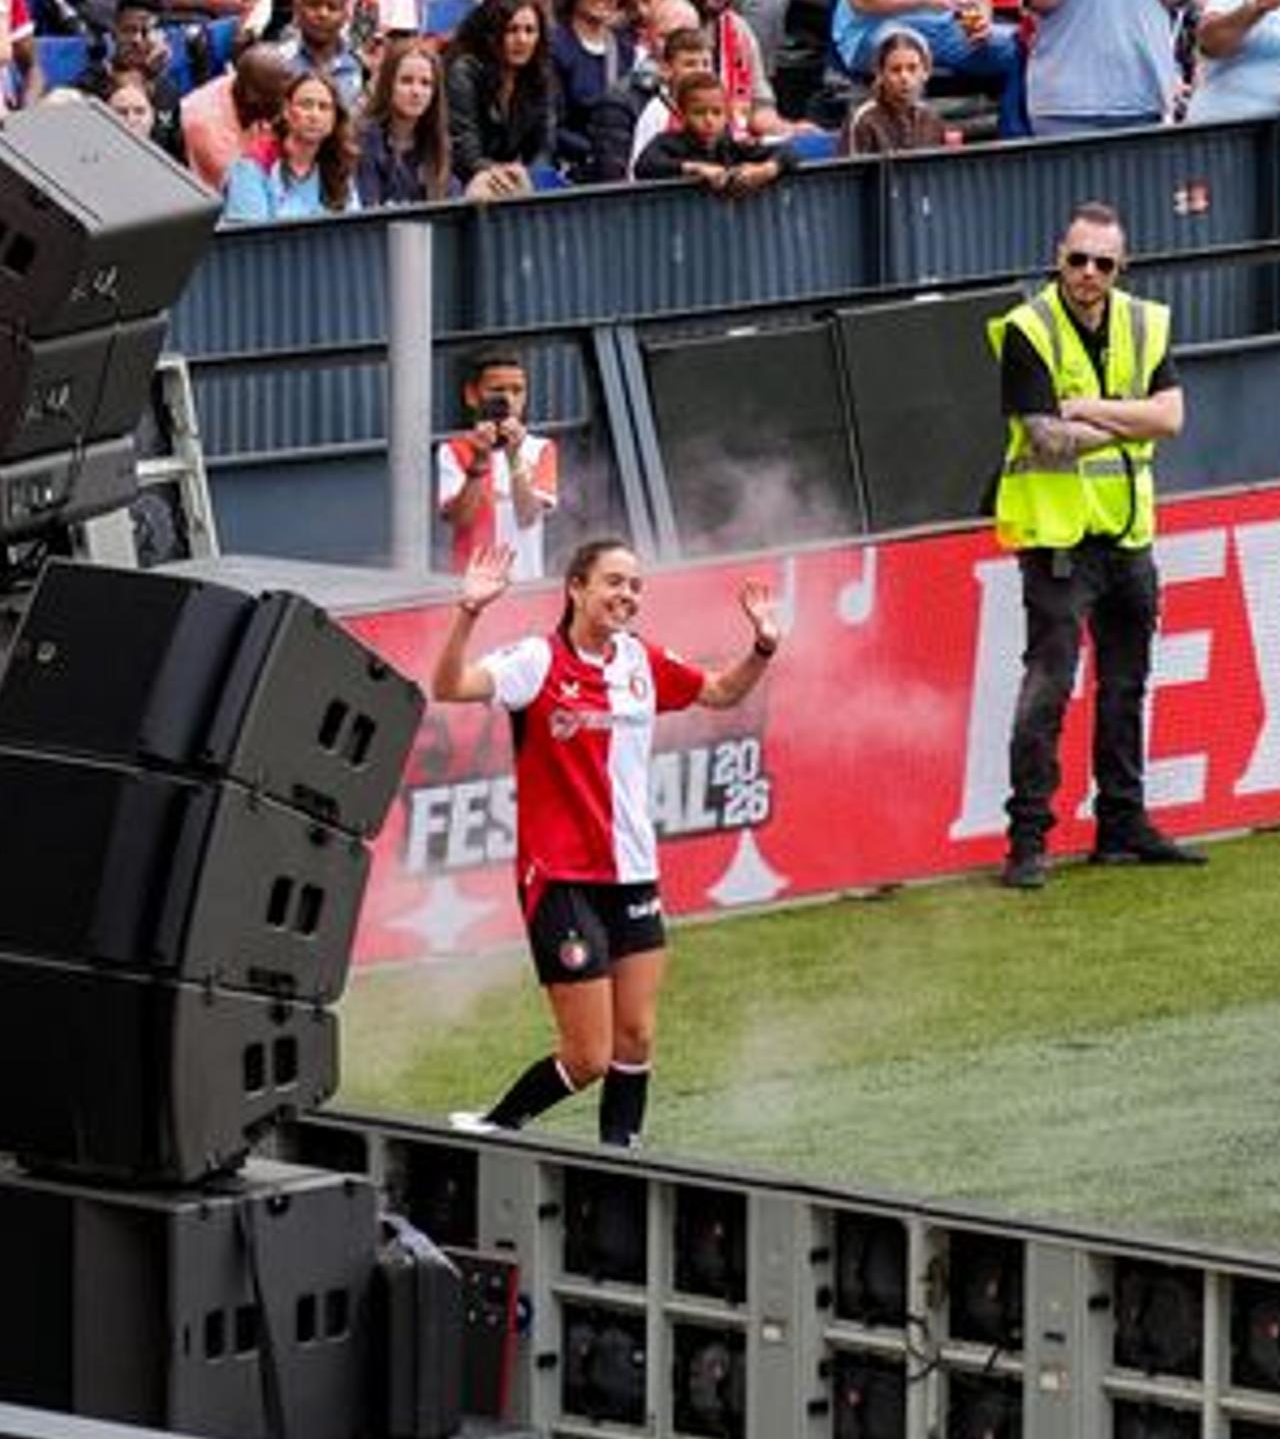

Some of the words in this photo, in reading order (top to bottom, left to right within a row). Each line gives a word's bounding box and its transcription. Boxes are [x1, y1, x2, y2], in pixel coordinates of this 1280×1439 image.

[406, 750, 717, 872] FESAL
[712, 737, 760, 786] 20
[723, 779, 771, 824] 26
